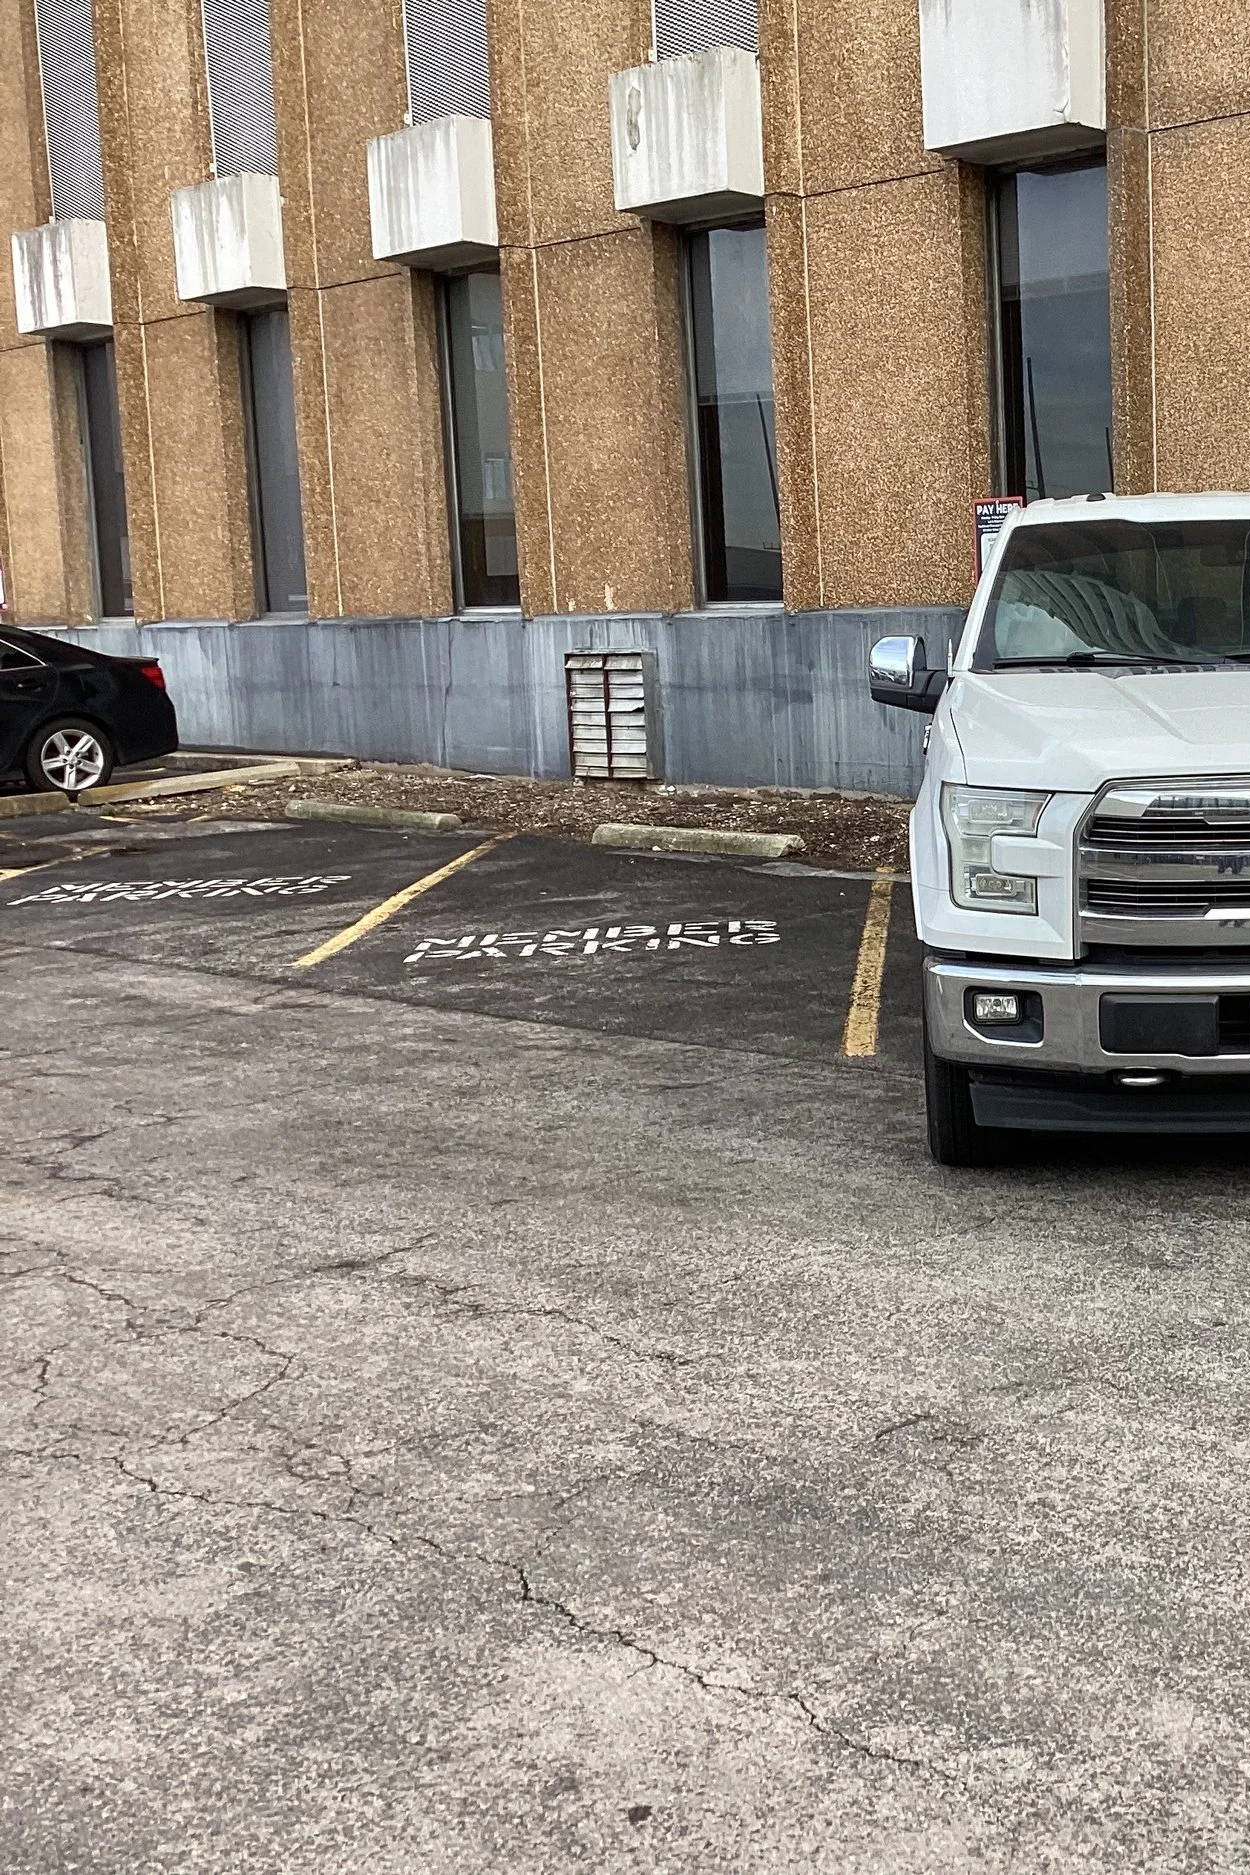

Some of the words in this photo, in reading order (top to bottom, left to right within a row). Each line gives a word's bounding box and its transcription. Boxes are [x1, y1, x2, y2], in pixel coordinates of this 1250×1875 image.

[976, 504, 994, 515] PAY
[996, 503, 1018, 514] HER
[6, 884, 328, 906] PARKING
[40, 875, 352, 894] MEMBER
[414, 920, 778, 951] MEMBER
[403, 933, 781, 963] PARKING
